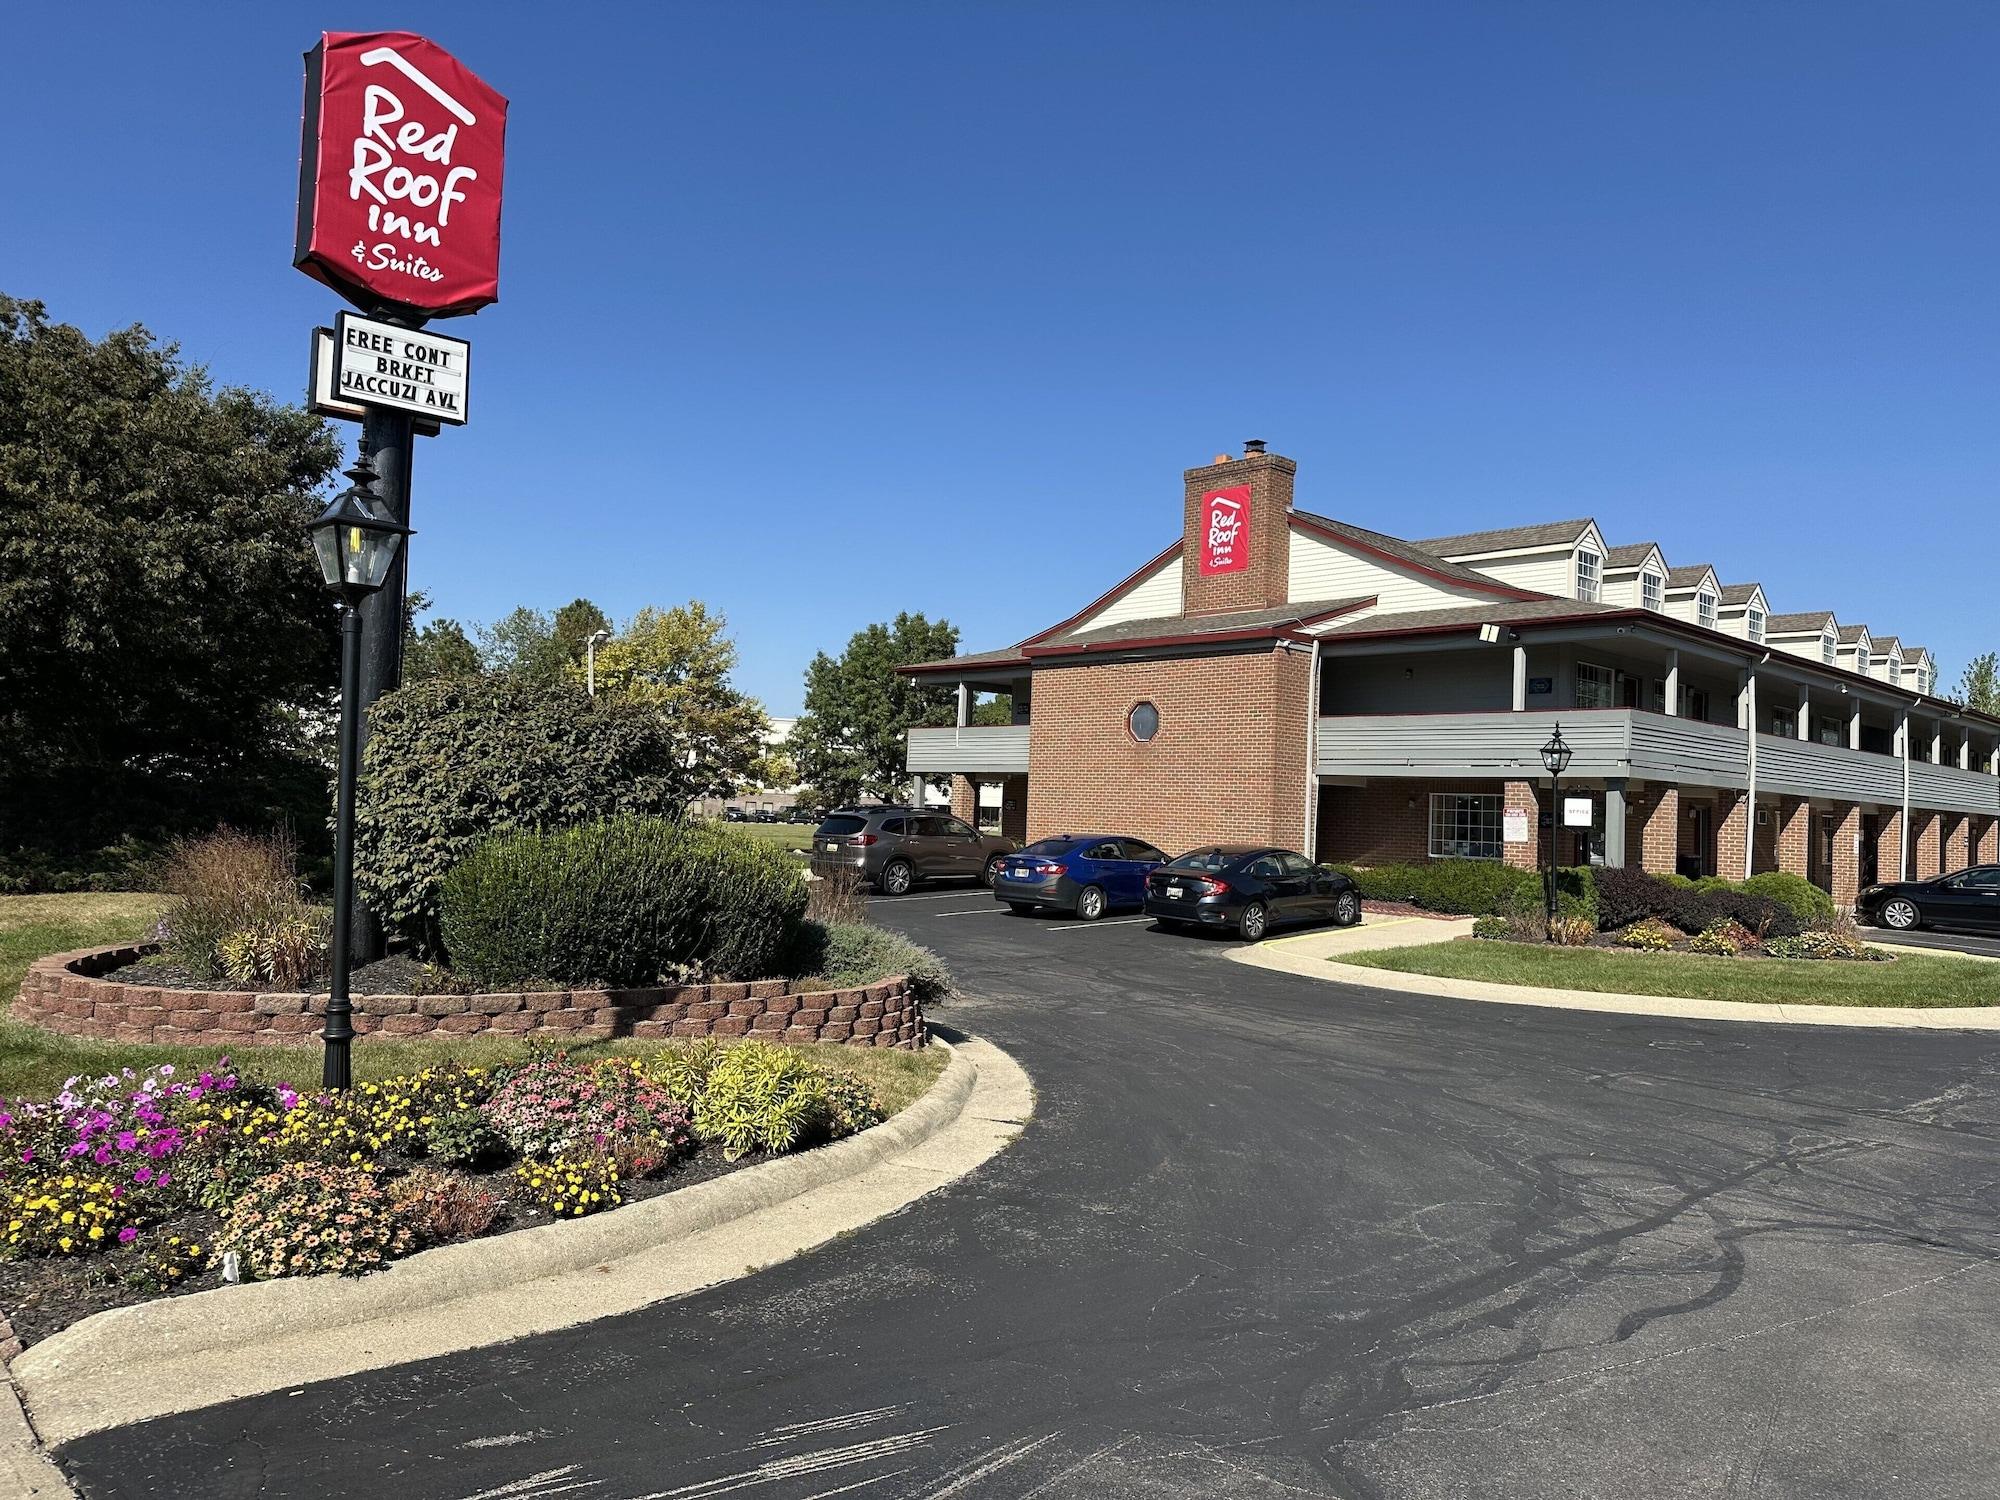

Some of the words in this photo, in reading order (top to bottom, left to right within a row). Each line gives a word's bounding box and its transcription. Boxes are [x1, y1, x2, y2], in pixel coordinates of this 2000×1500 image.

[363, 85, 458, 165] Red
[349, 137, 477, 226] Roof
[368, 204, 441, 247] Inn
[351, 240, 367, 263] &
[366, 243, 444, 282] Suites
[346, 328, 393, 355] FREE
[404, 342, 450, 367] CONT
[342, 371, 417, 401] JACCUZI
[426, 389, 457, 410] AVL
[1208, 522, 1241, 548] Roof
[1211, 510, 1236, 528] Red
